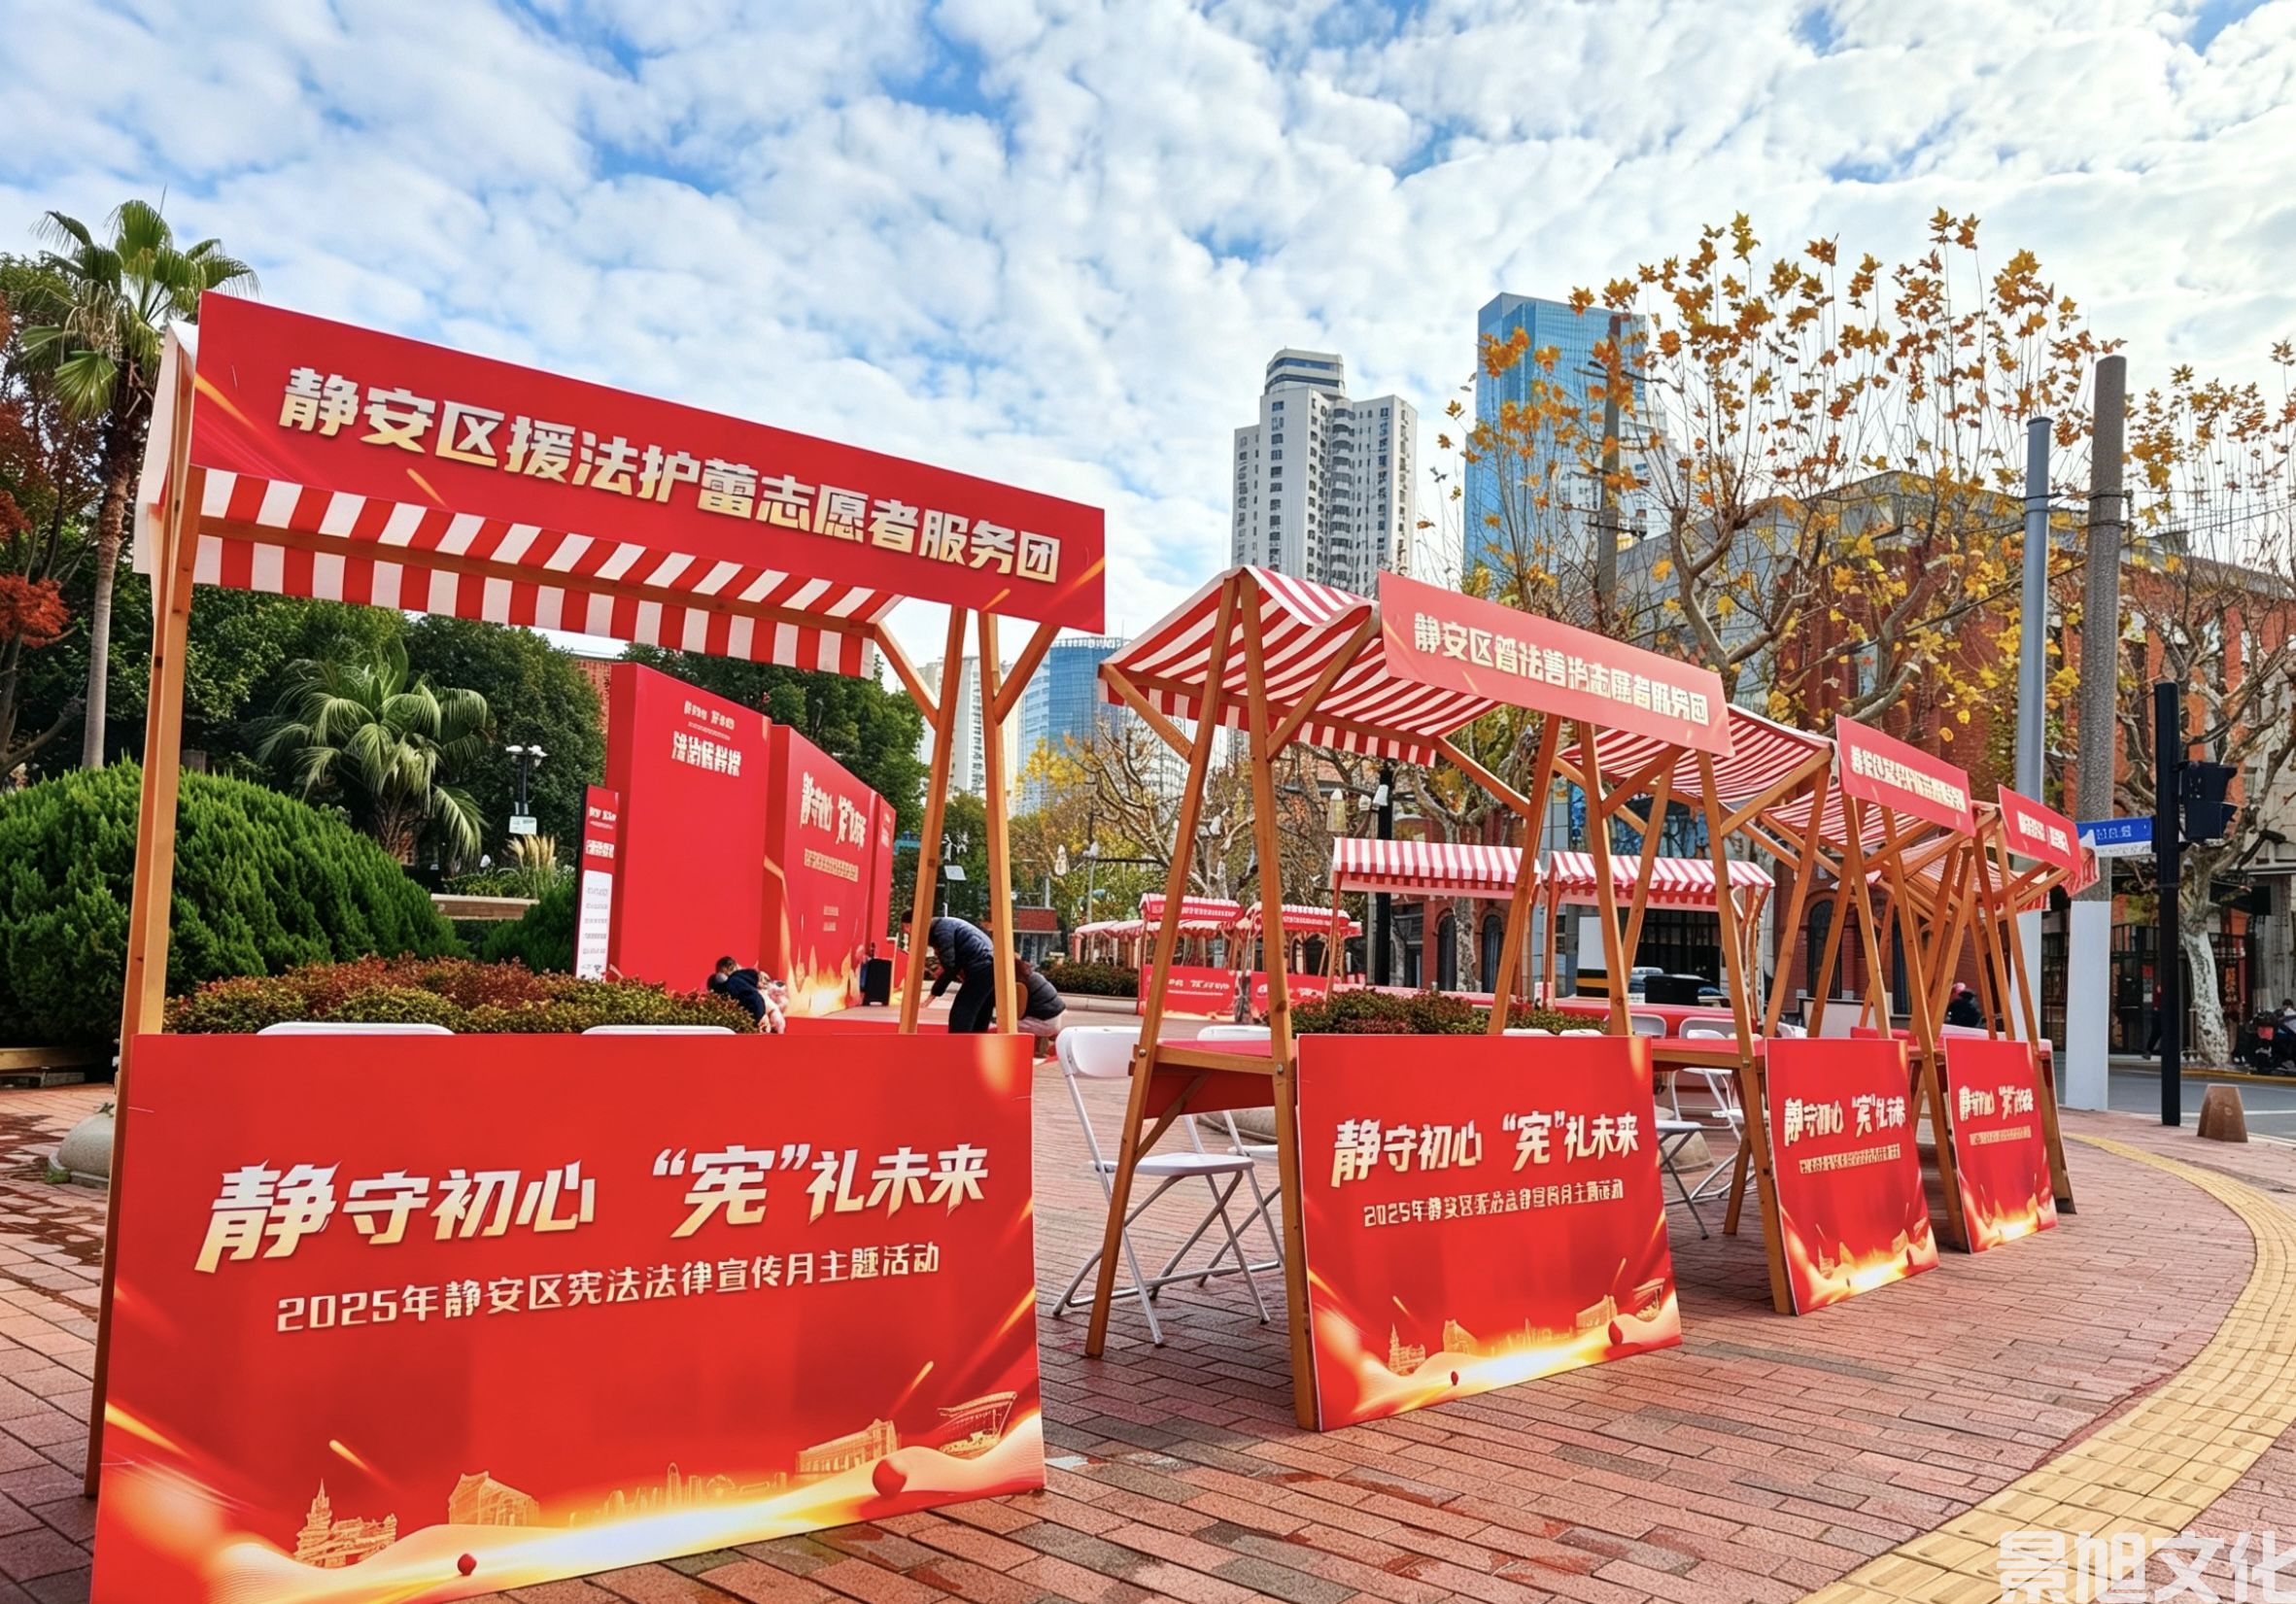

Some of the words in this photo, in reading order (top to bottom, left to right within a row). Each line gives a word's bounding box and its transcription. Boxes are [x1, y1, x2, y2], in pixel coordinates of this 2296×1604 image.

[279, 367, 1059, 584] 静安区援法护蕾志愿者服务团
[1331, 1118, 1483, 1188] 静守初心
[1502, 1110, 1639, 1172] “宪”礼未来
[195, 1160, 596, 1274] 静守初心
[653, 1143, 987, 1238] “宪”礼未来
[277, 1242, 940, 1332] 2025年静安区宪法法律宣传月主题活动
